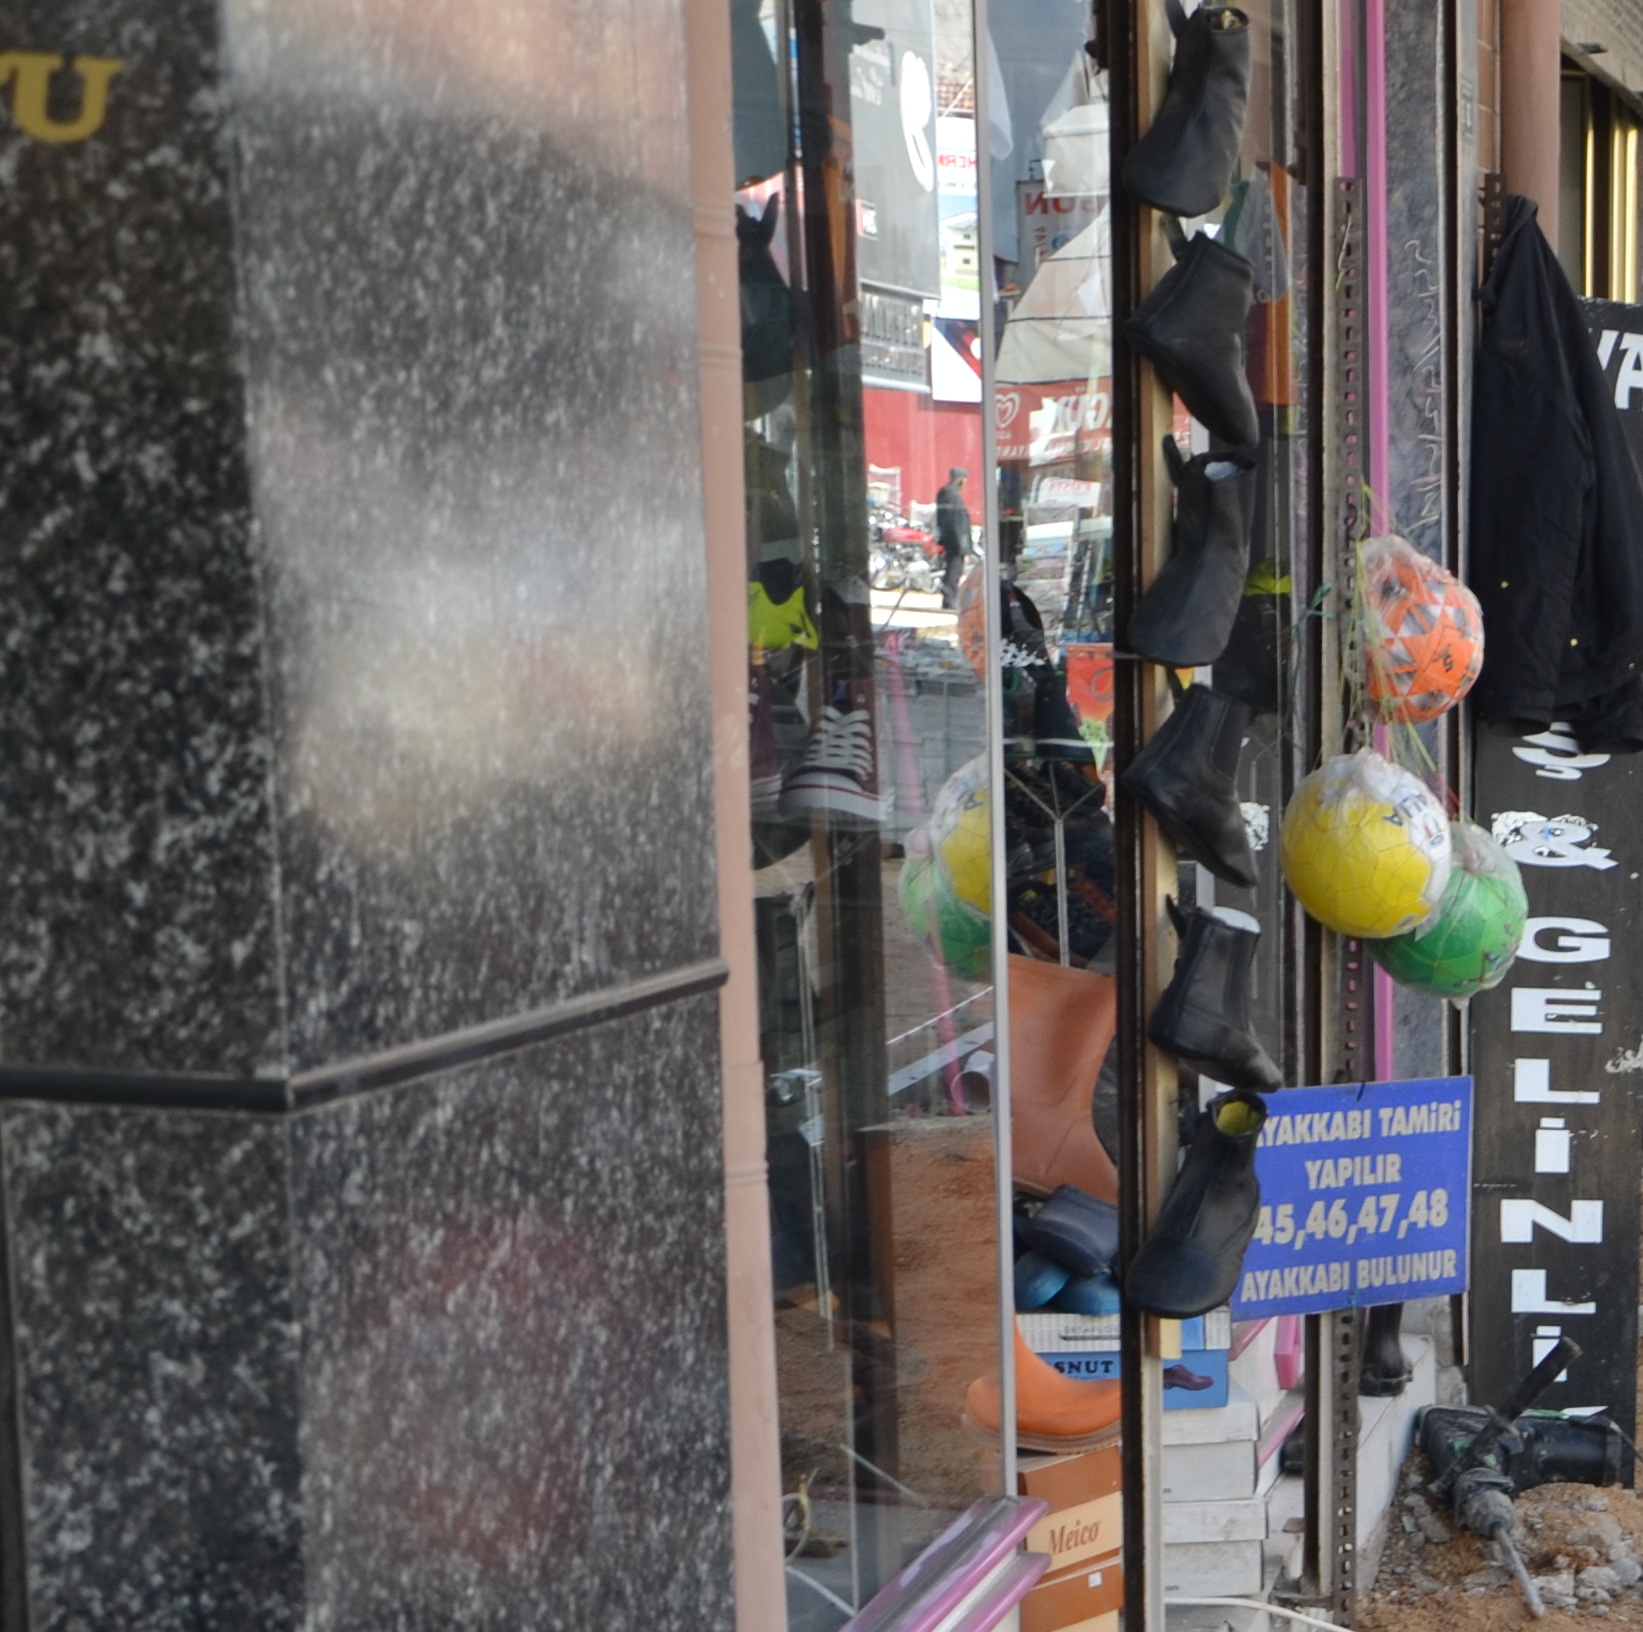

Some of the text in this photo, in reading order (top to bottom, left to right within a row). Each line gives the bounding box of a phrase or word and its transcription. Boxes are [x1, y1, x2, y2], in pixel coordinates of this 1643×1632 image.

[0, 50, 124, 144] U
[1305, 1153, 1402, 1190] YAPILIR
[1241, 1249, 1457, 1303] AYAKKABI BULUNUR
[1055, 1360, 1114, 1374] SNUT
[1050, 1518, 1100, 1556] Meico
